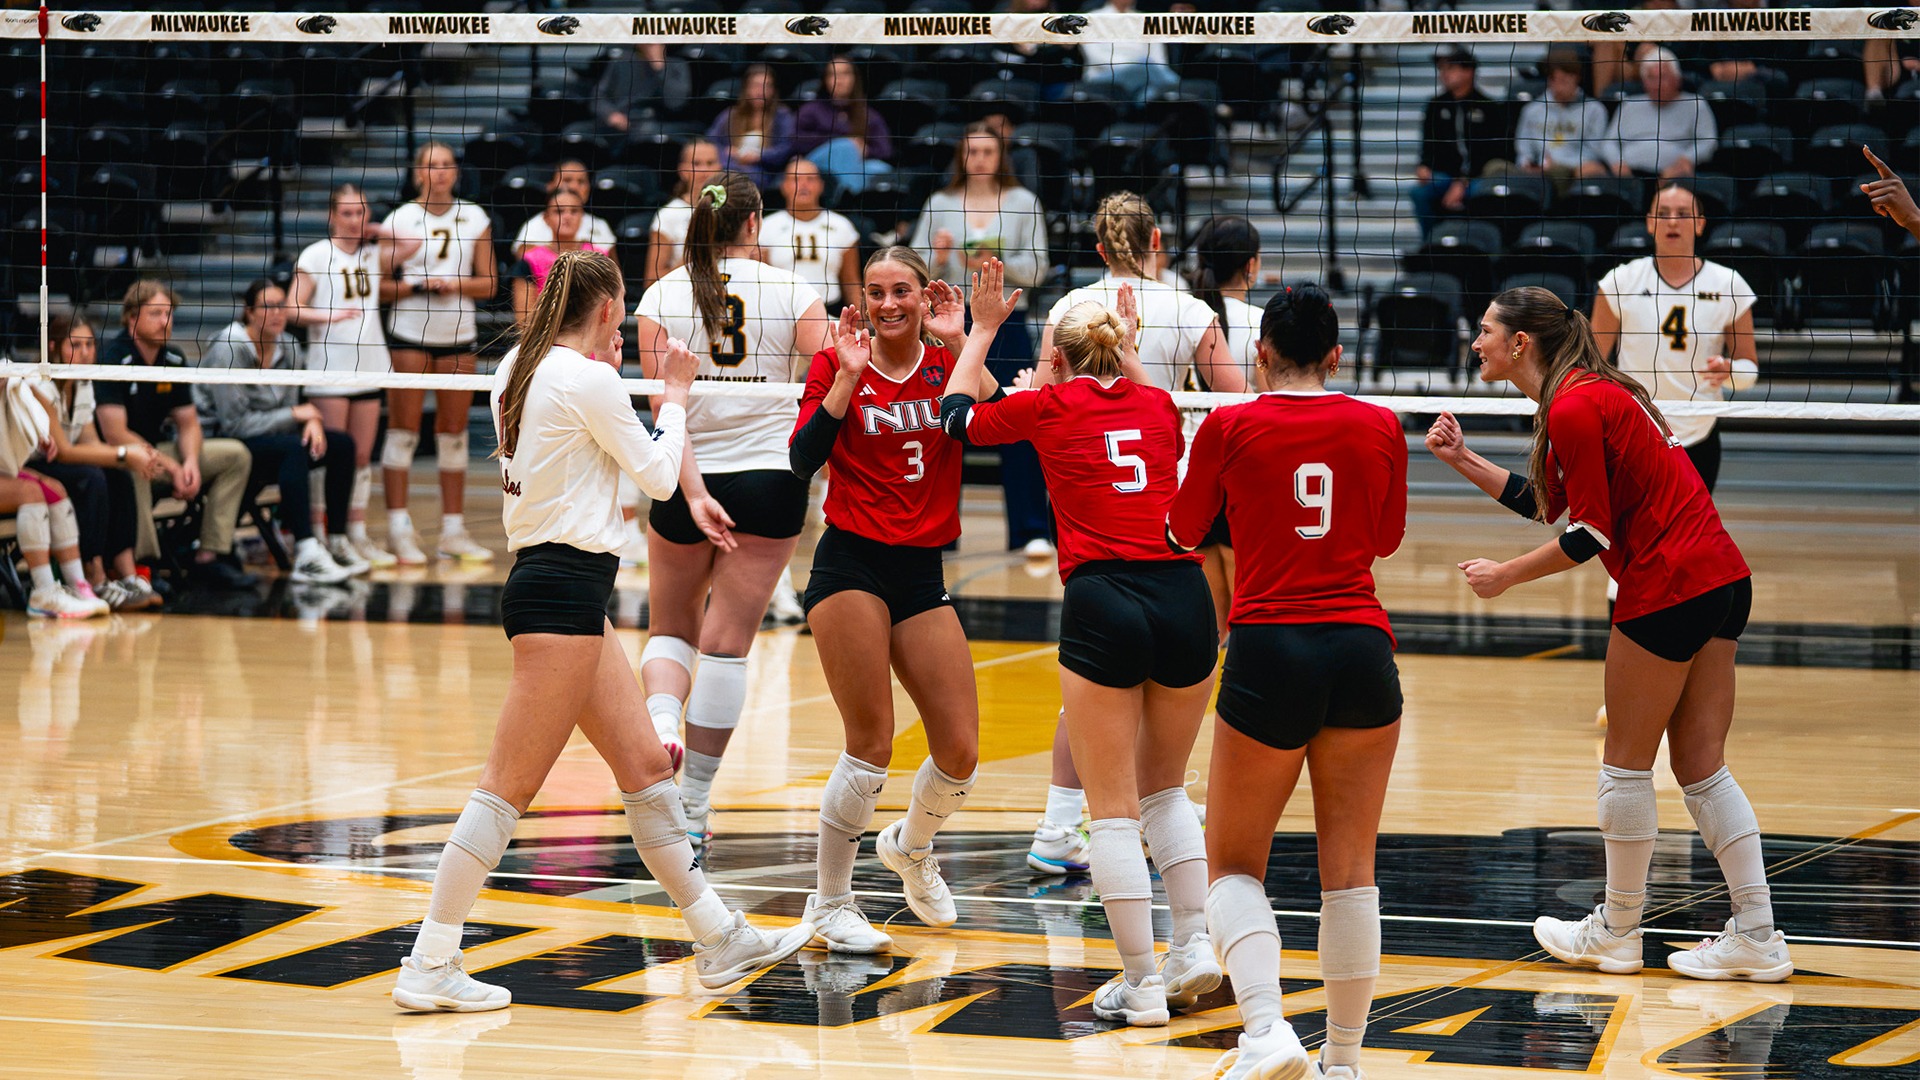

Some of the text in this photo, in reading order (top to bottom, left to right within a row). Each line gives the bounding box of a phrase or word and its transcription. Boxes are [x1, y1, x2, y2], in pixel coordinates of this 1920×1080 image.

[151, 14, 249, 33] MILWAUKEE
[389, 17, 491, 35] MILWAUKEE
[632, 16, 737, 35] MILWAUKEE
[884, 16, 991, 36] MILWAUKEE
[1143, 16, 1255, 35] MILWAUKEE
[1412, 14, 1528, 34] MILWAUKEE
[1690, 12, 1812, 32] MILWAUKEE
[431, 228, 450, 259] 7
[796, 234, 818, 260] 11
[342, 268, 371, 299] 10
[709, 293, 747, 368] 3
[1661, 305, 1688, 351] 4
[902, 440, 925, 482] 3
[1104, 429, 1148, 493] 5
[1294, 462, 1333, 539] 9
